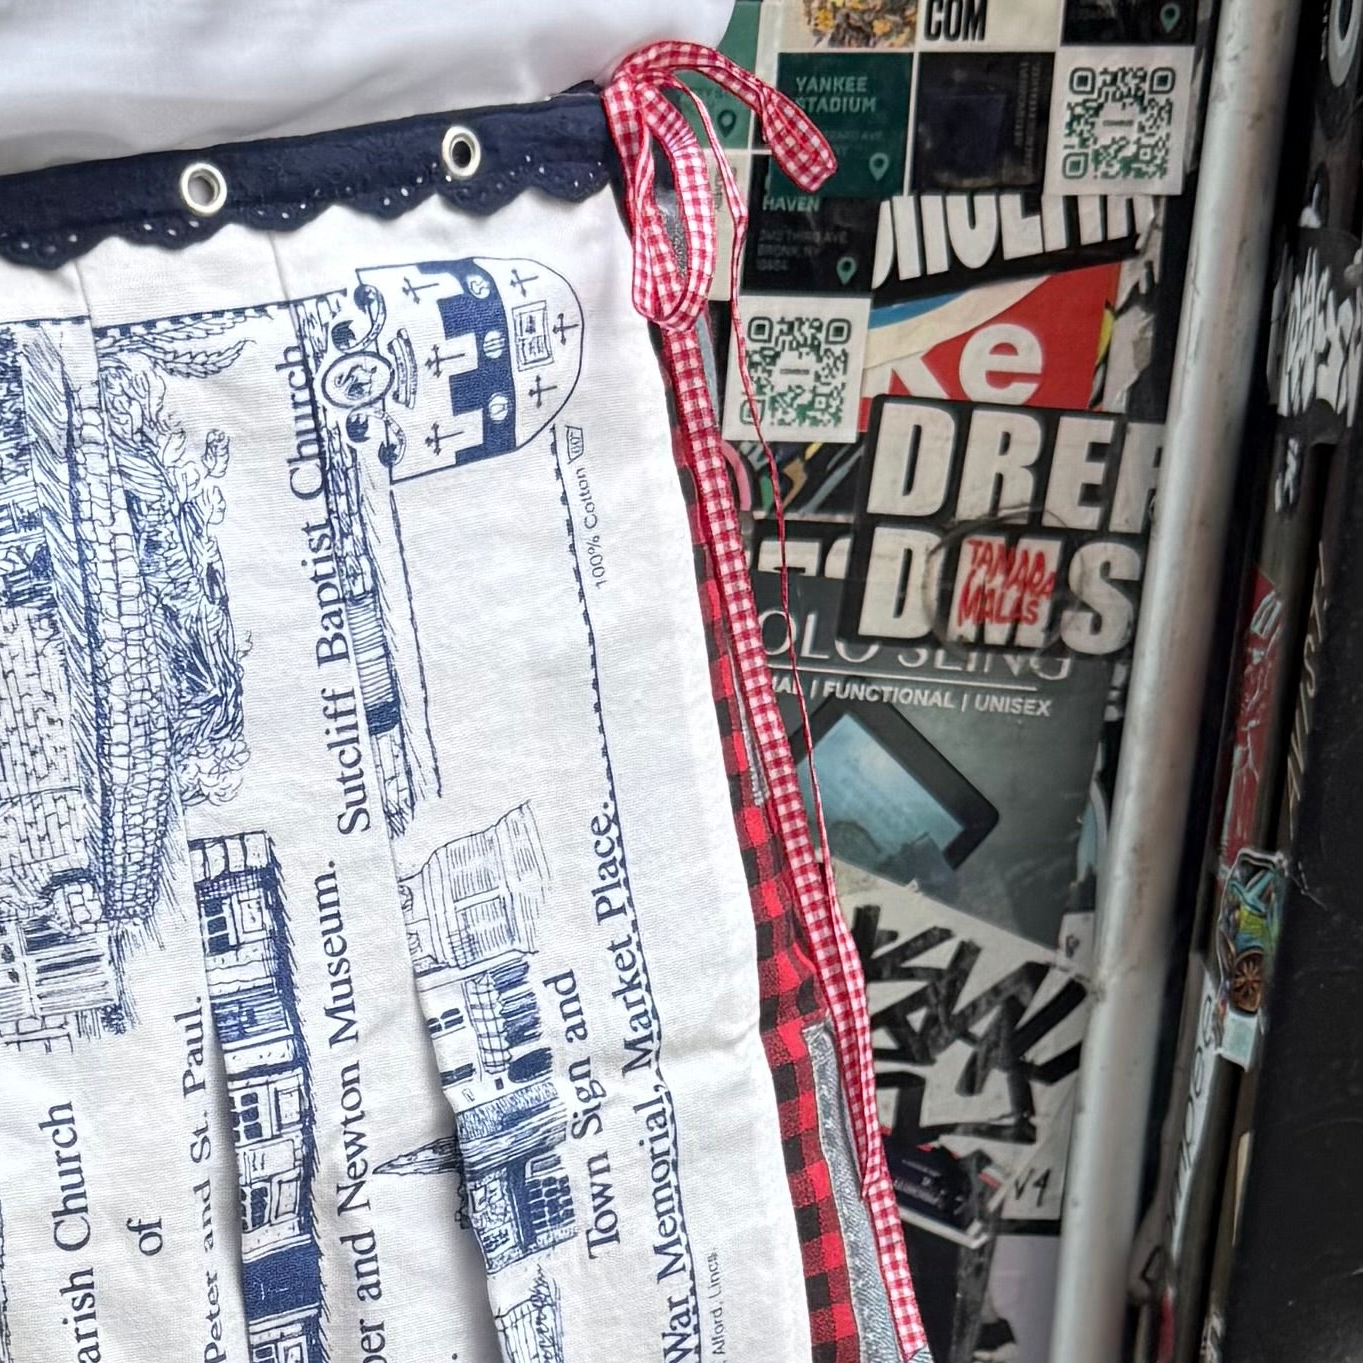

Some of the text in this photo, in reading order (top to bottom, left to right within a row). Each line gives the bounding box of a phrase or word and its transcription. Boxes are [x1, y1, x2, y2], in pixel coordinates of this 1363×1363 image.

[795, 97, 877, 113] STADIUM
[796, 76, 868, 92] YANKEE
[762, 196, 819, 212] HAVEN
[575, 466, 599, 530] Cotton
[273, 343, 372, 836] Sutcliff Baptist Church
[585, 535, 609, 590] 100%
[823, 683, 955, 710] FUNCTIONAL
[974, 694, 1052, 717] UNISEX
[592, 801, 626, 926] Place.
[314, 859, 361, 1049] Museum.
[611, 931, 653, 1079] Market
[173, 996, 207, 1100] Paul.
[190, 1111, 211, 1164] St.
[329, 1060, 374, 1216] Newton
[544, 968, 621, 1258] Town Sign and
[38, 1100, 92, 1253] Church
[195, 1180, 215, 1254] and
[633, 1082, 690, 1284] Memorial,
[126, 1216, 164, 1256] of
[343, 1223, 384, 1305] and
